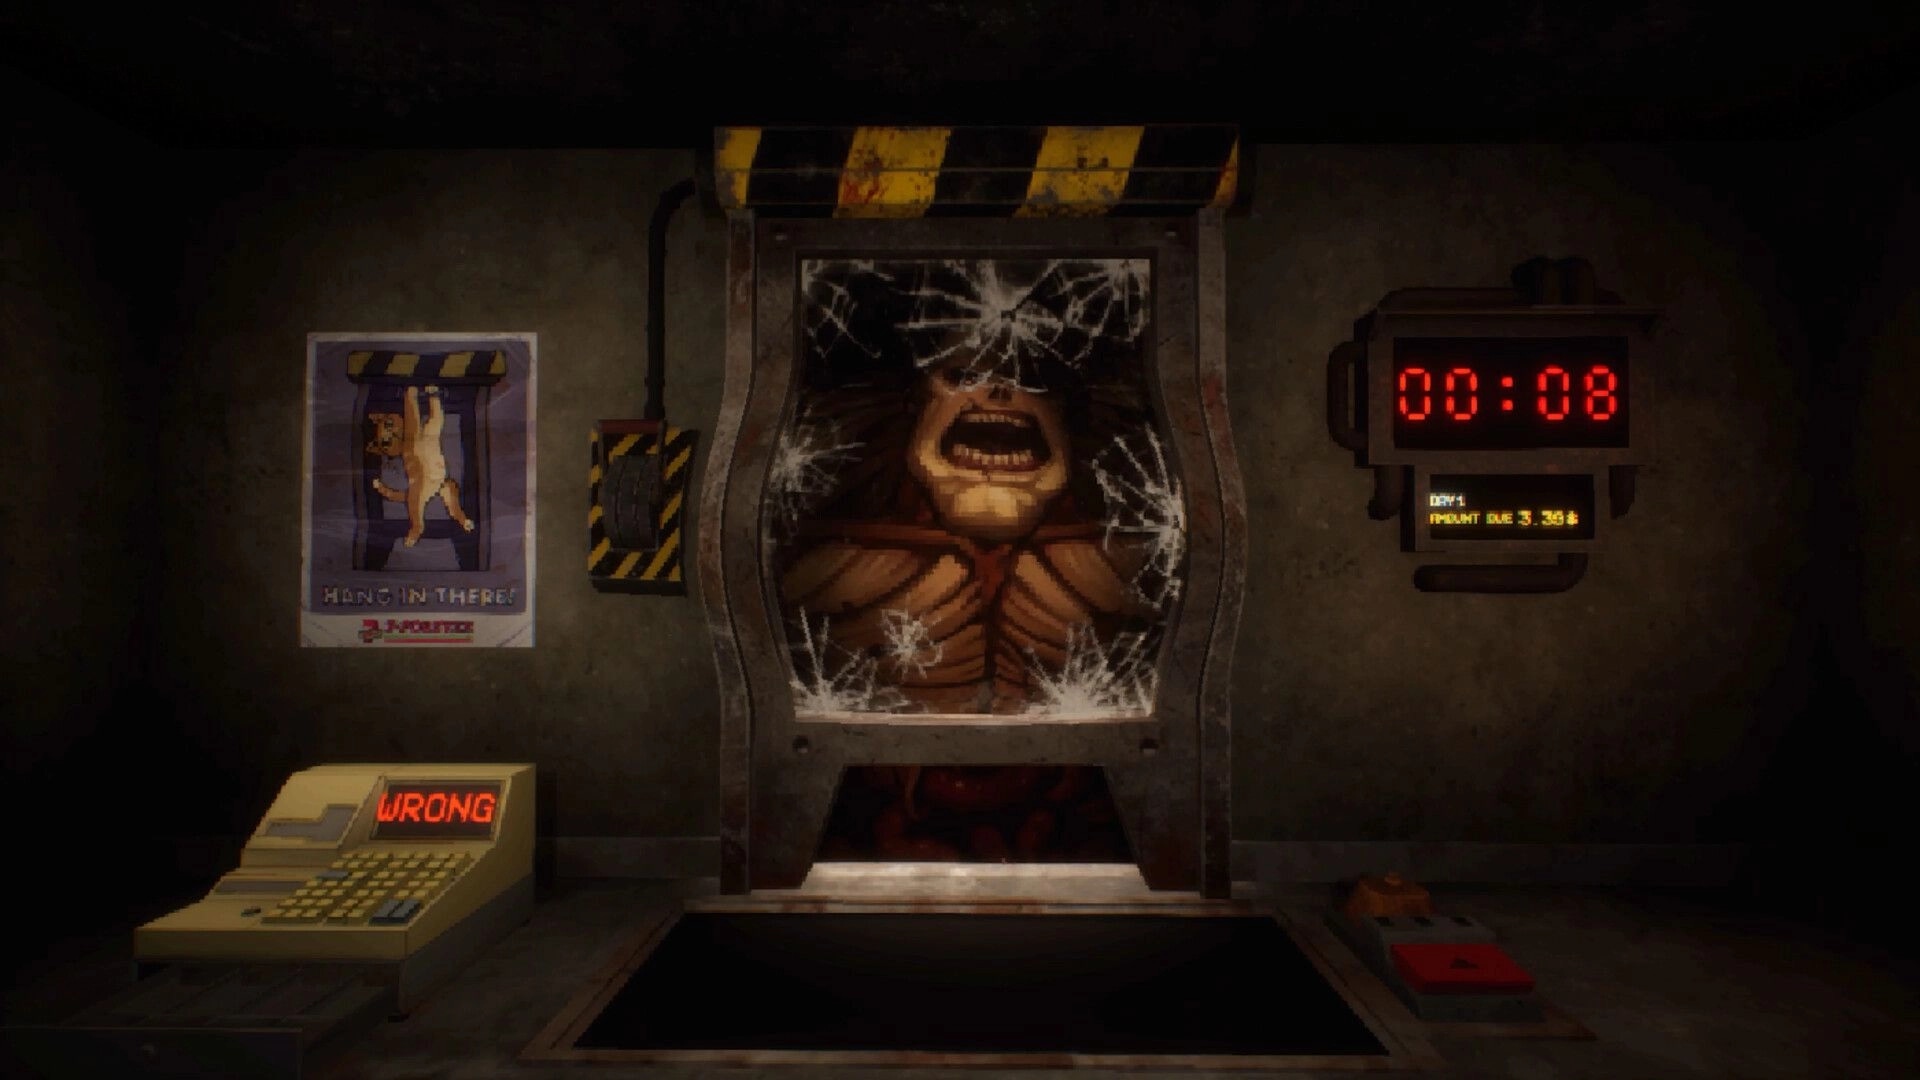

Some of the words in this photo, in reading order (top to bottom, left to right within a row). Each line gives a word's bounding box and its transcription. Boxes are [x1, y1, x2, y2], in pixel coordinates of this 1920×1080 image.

[1399, 366, 1617, 421] 00:08
[1429, 512, 1480, 525] AMOUNT
[1486, 512, 1514, 525] DUE
[322, 585, 392, 607] HANG
[399, 585, 428, 606] IN
[434, 585, 517, 607] THERE!
[377, 792, 496, 823] WRONG
